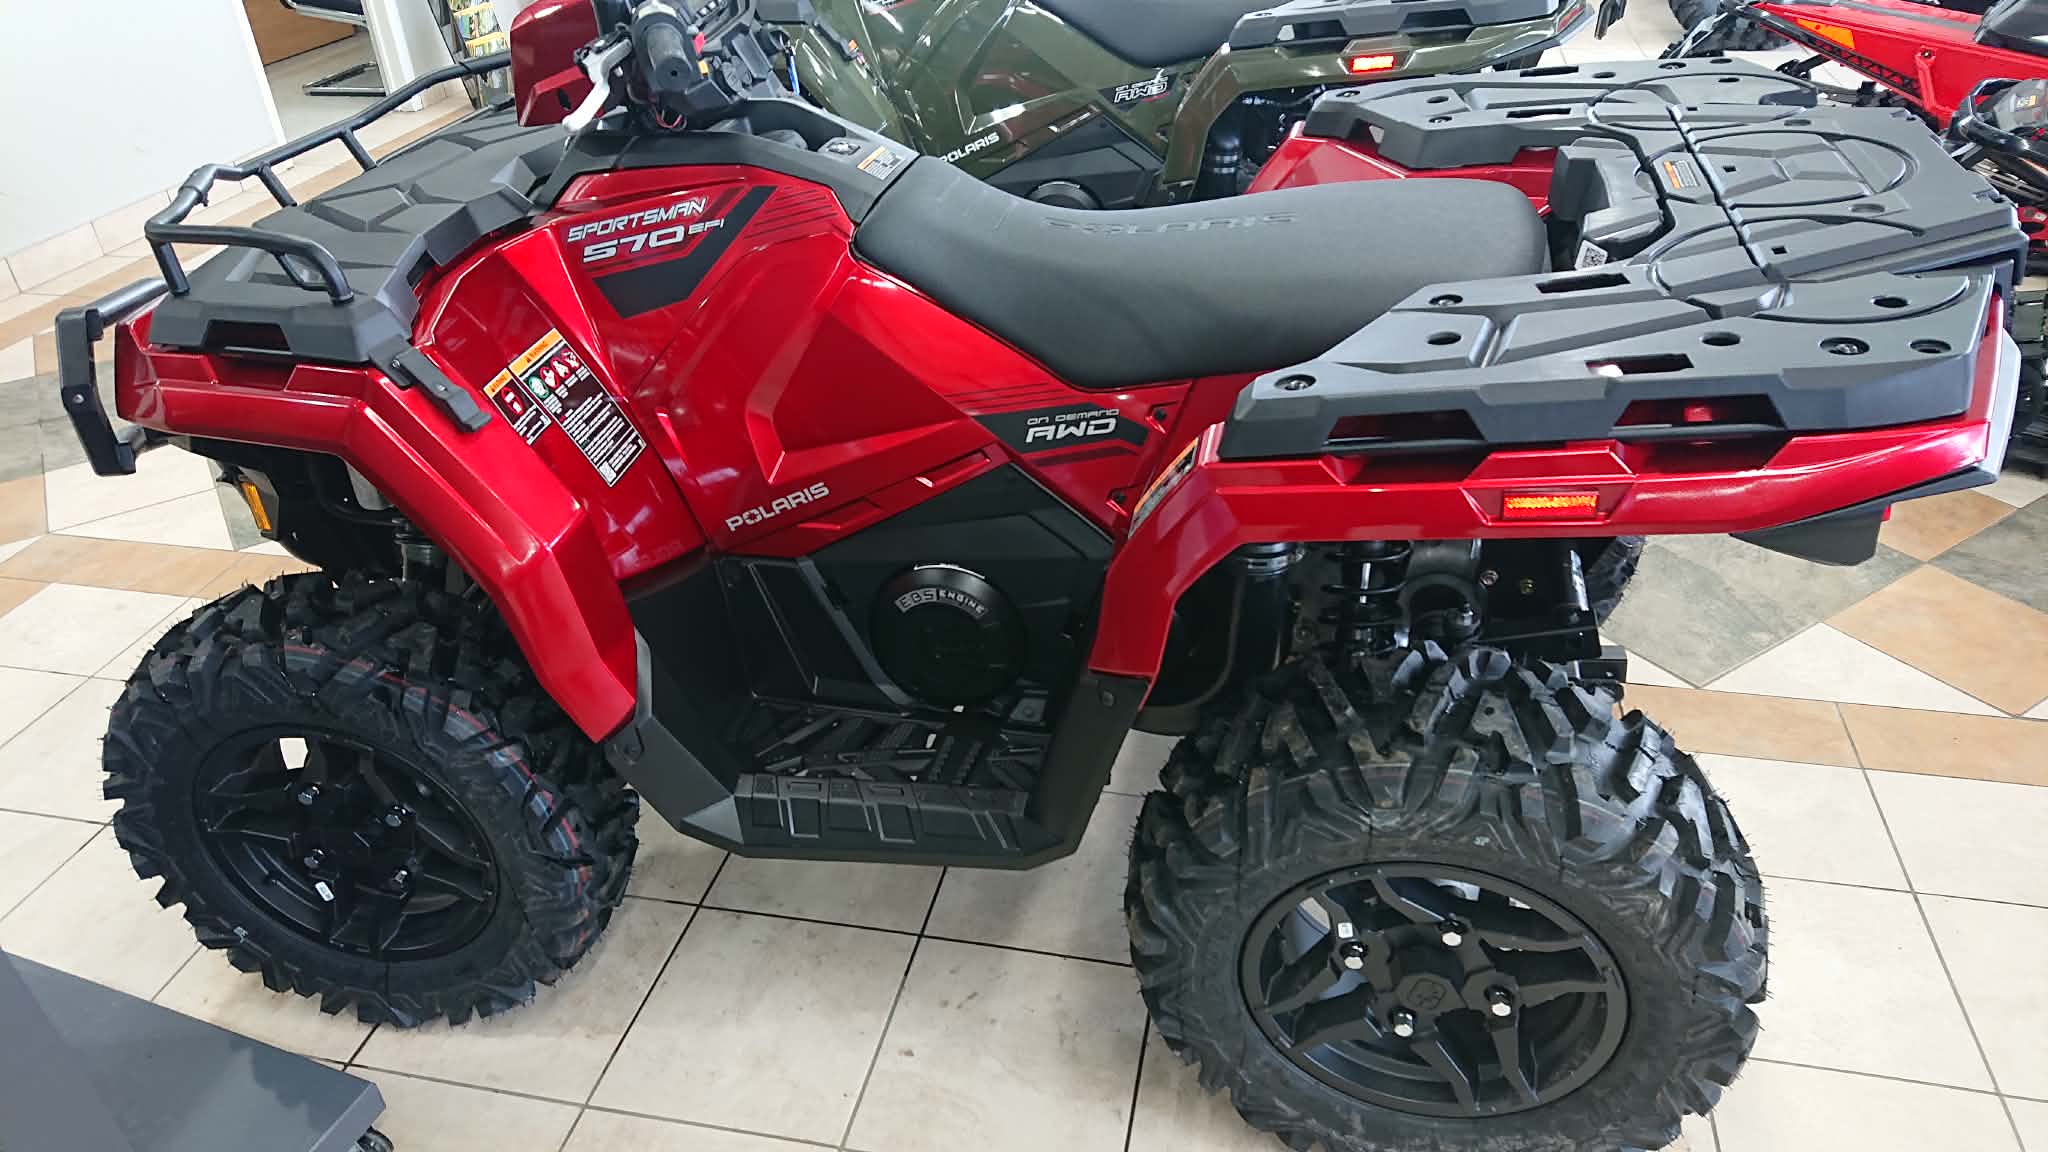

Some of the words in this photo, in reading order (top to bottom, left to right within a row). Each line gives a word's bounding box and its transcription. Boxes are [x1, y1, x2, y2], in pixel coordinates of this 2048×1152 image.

[1114, 82, 1168, 103] AWD
[567, 199, 707, 243] SPORTSMAN
[583, 225, 685, 263] 570
[688, 219, 725, 235] EFI
[1025, 417, 1117, 443] AWD
[1027, 416, 1050, 426] ON
[1055, 408, 1120, 423] DEMAND
[725, 481, 830, 532] POLARIS
[939, 590, 986, 614] ENGINE
